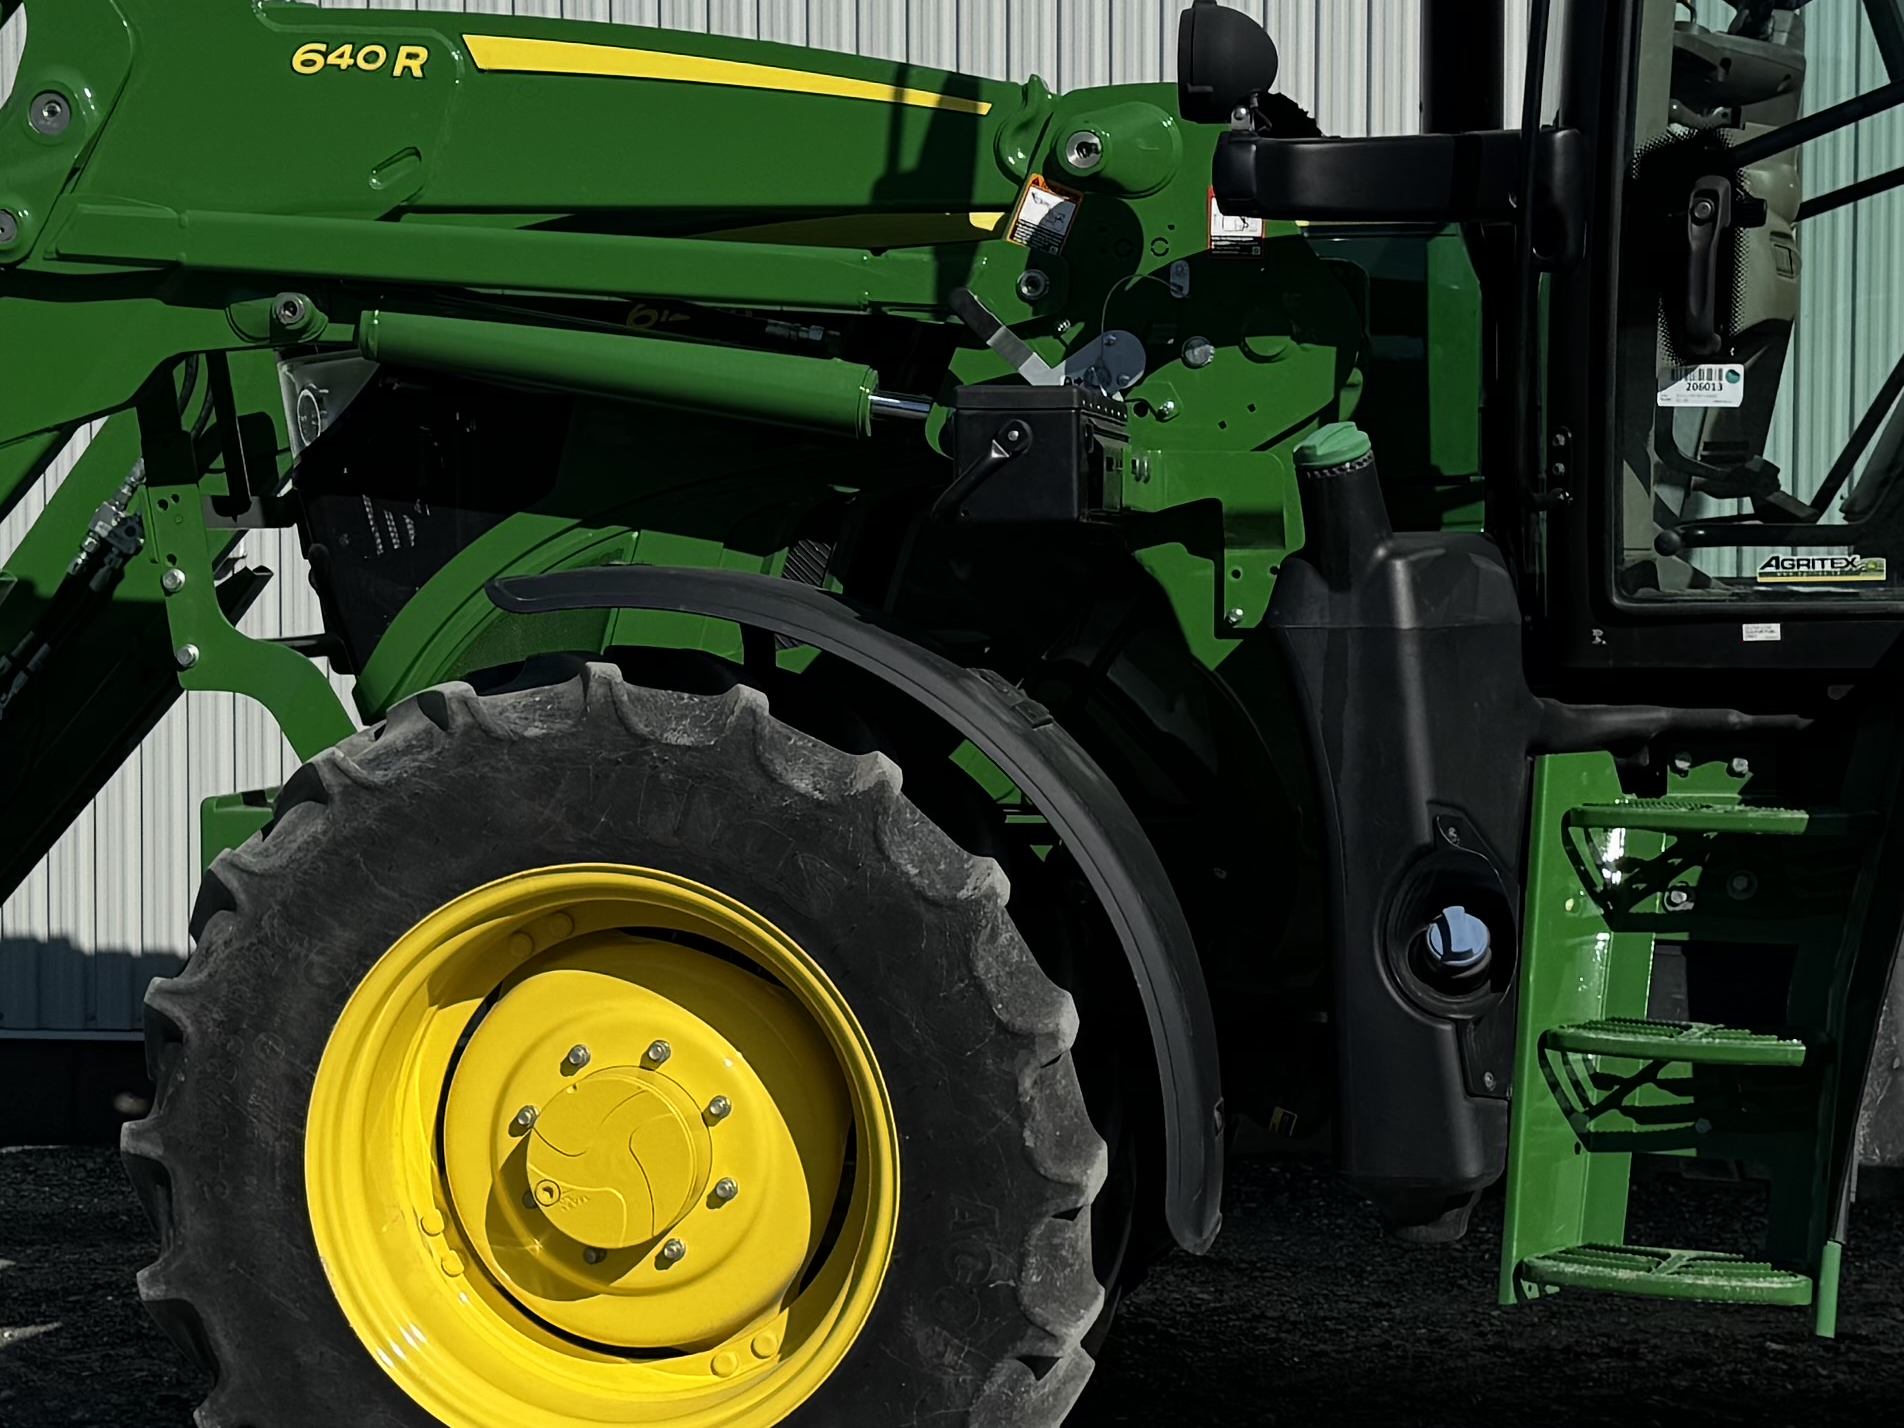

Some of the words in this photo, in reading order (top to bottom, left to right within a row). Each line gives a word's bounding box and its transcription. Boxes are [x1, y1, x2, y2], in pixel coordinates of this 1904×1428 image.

[291, 43, 387, 75] 640
[393, 46, 428, 78] R
[1760, 555, 1858, 570] AGRITEX
